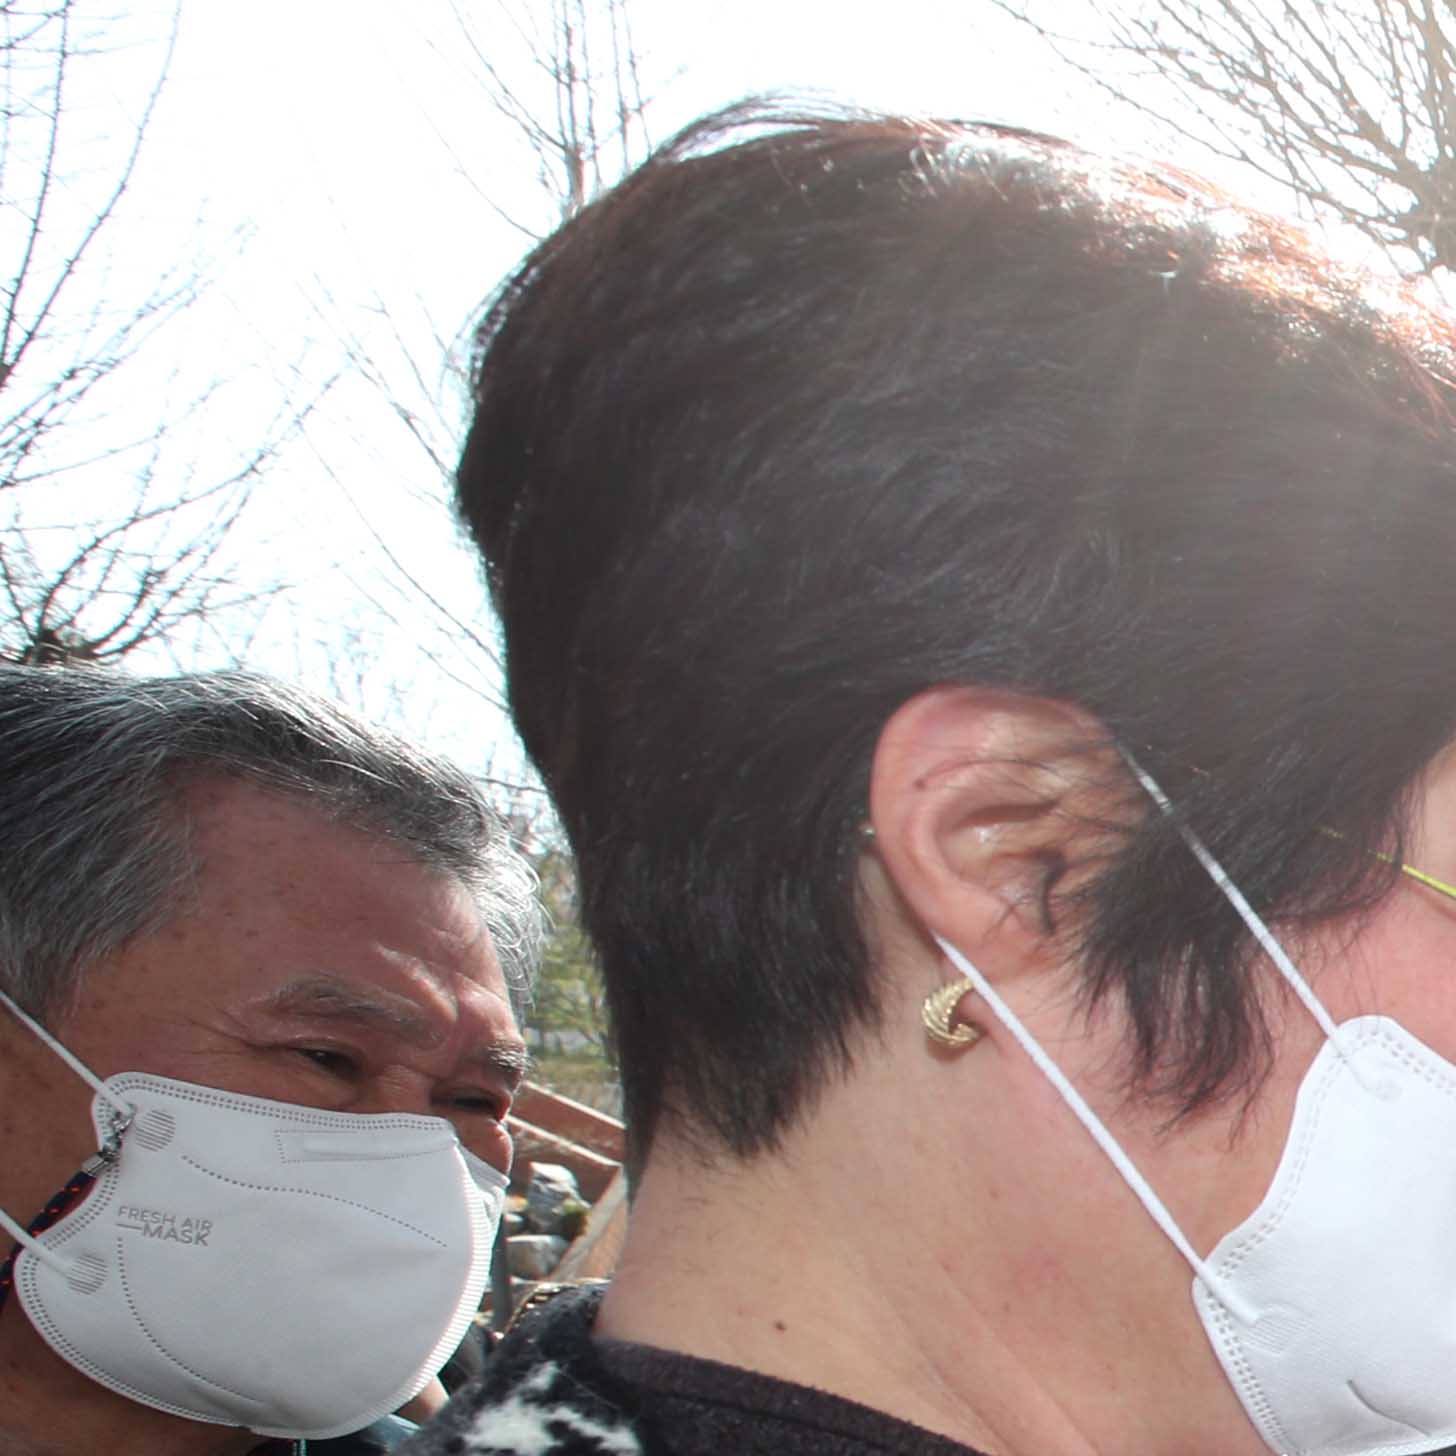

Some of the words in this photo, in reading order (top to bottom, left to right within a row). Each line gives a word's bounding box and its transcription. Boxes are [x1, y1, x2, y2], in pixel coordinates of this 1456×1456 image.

[118, 1205, 176, 1226] FRESH
[181, 1217, 213, 1234] AIR
[143, 1222, 208, 1247] MASK
